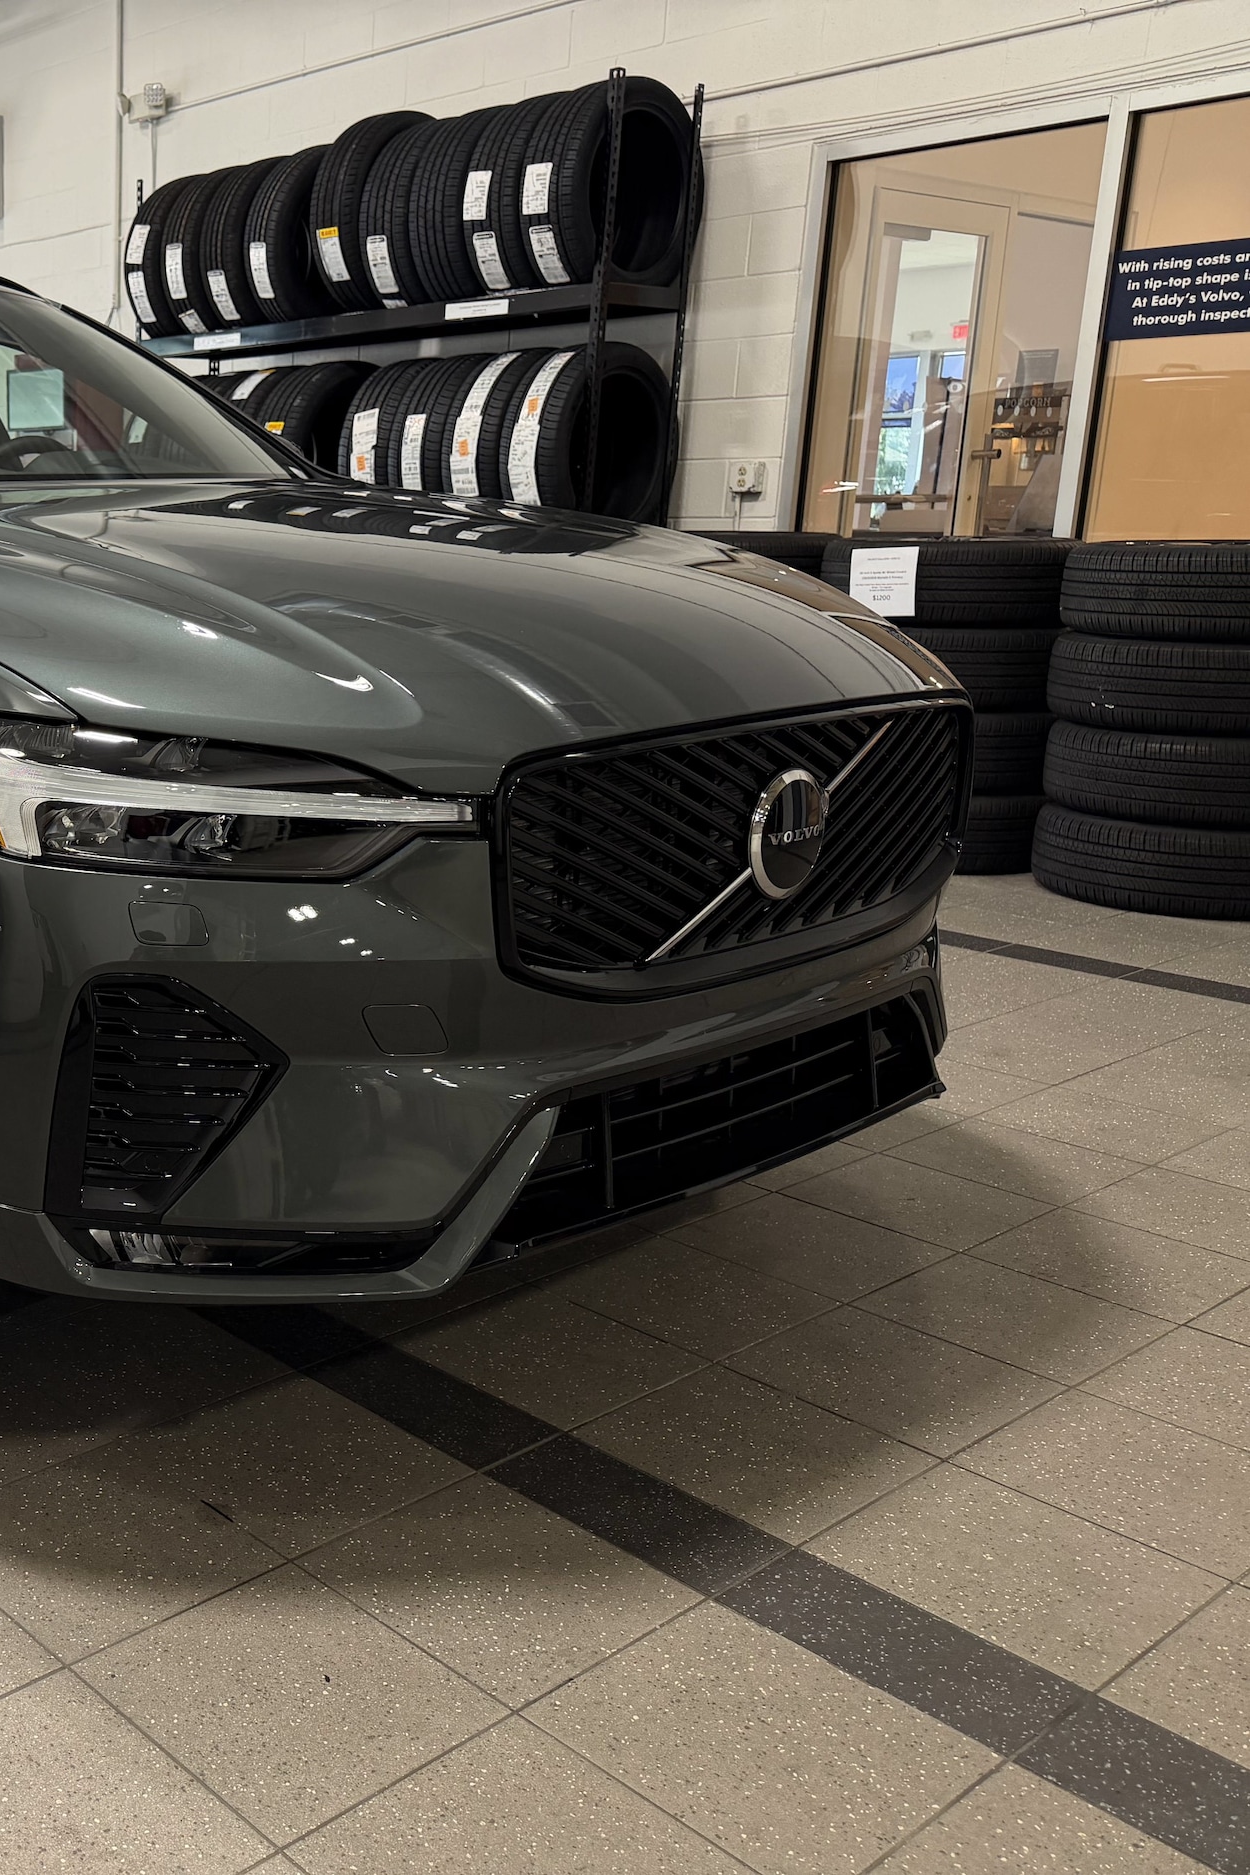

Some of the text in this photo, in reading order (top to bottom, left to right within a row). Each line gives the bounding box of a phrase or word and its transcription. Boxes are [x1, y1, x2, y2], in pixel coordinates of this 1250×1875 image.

[1118, 260, 1149, 274] With
[1152, 256, 1192, 271] rising
[1196, 253, 1231, 267] costs
[1127, 280, 1140, 291] in
[1143, 276, 1192, 291] tip-top
[1195, 272, 1240, 286] shape
[1131, 289, 1245, 308] At Eddy's Volvo,
[1132, 310, 1196, 326] thorough
[1004, 396, 1051, 408] POPCORN
[767, 824, 820, 846] VOLVO
